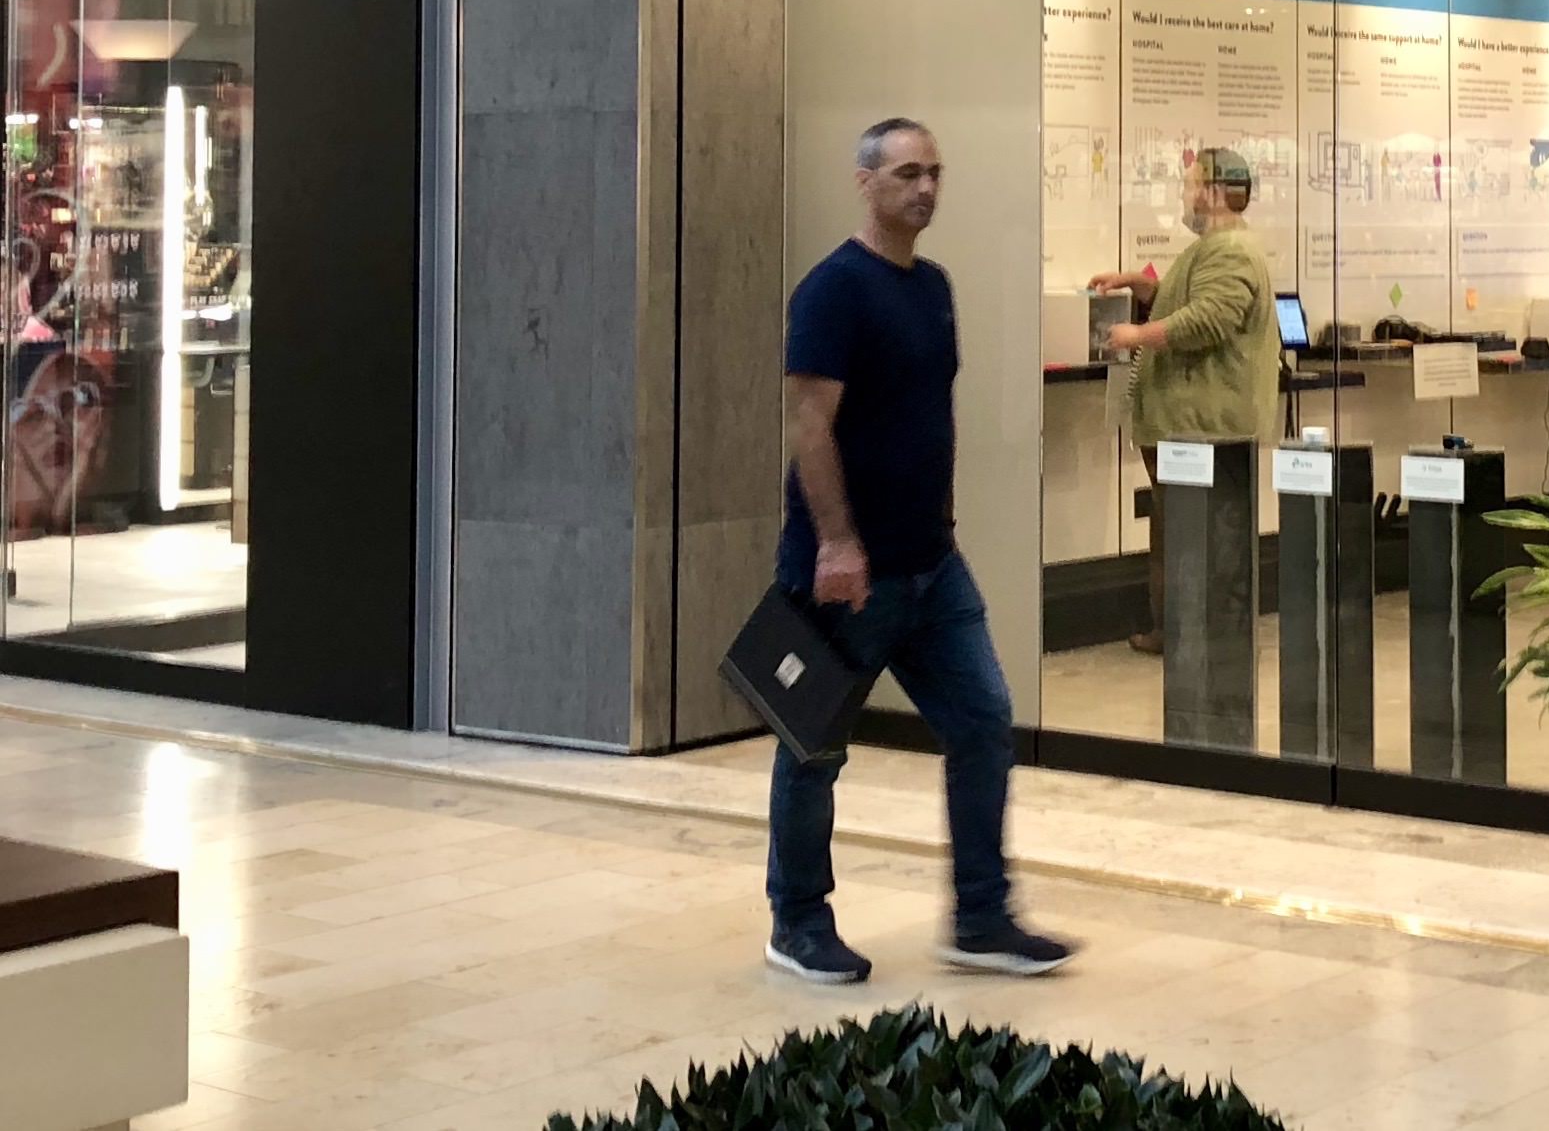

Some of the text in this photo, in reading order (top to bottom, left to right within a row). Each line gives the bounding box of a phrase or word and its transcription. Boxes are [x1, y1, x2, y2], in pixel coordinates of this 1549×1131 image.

[1062, 7, 1111, 23] experience?
[1132, 10, 1157, 24] Would
[1164, 15, 1191, 28] receive
[1193, 16, 1205, 28] the
[1250, 20, 1275, 34] home?
